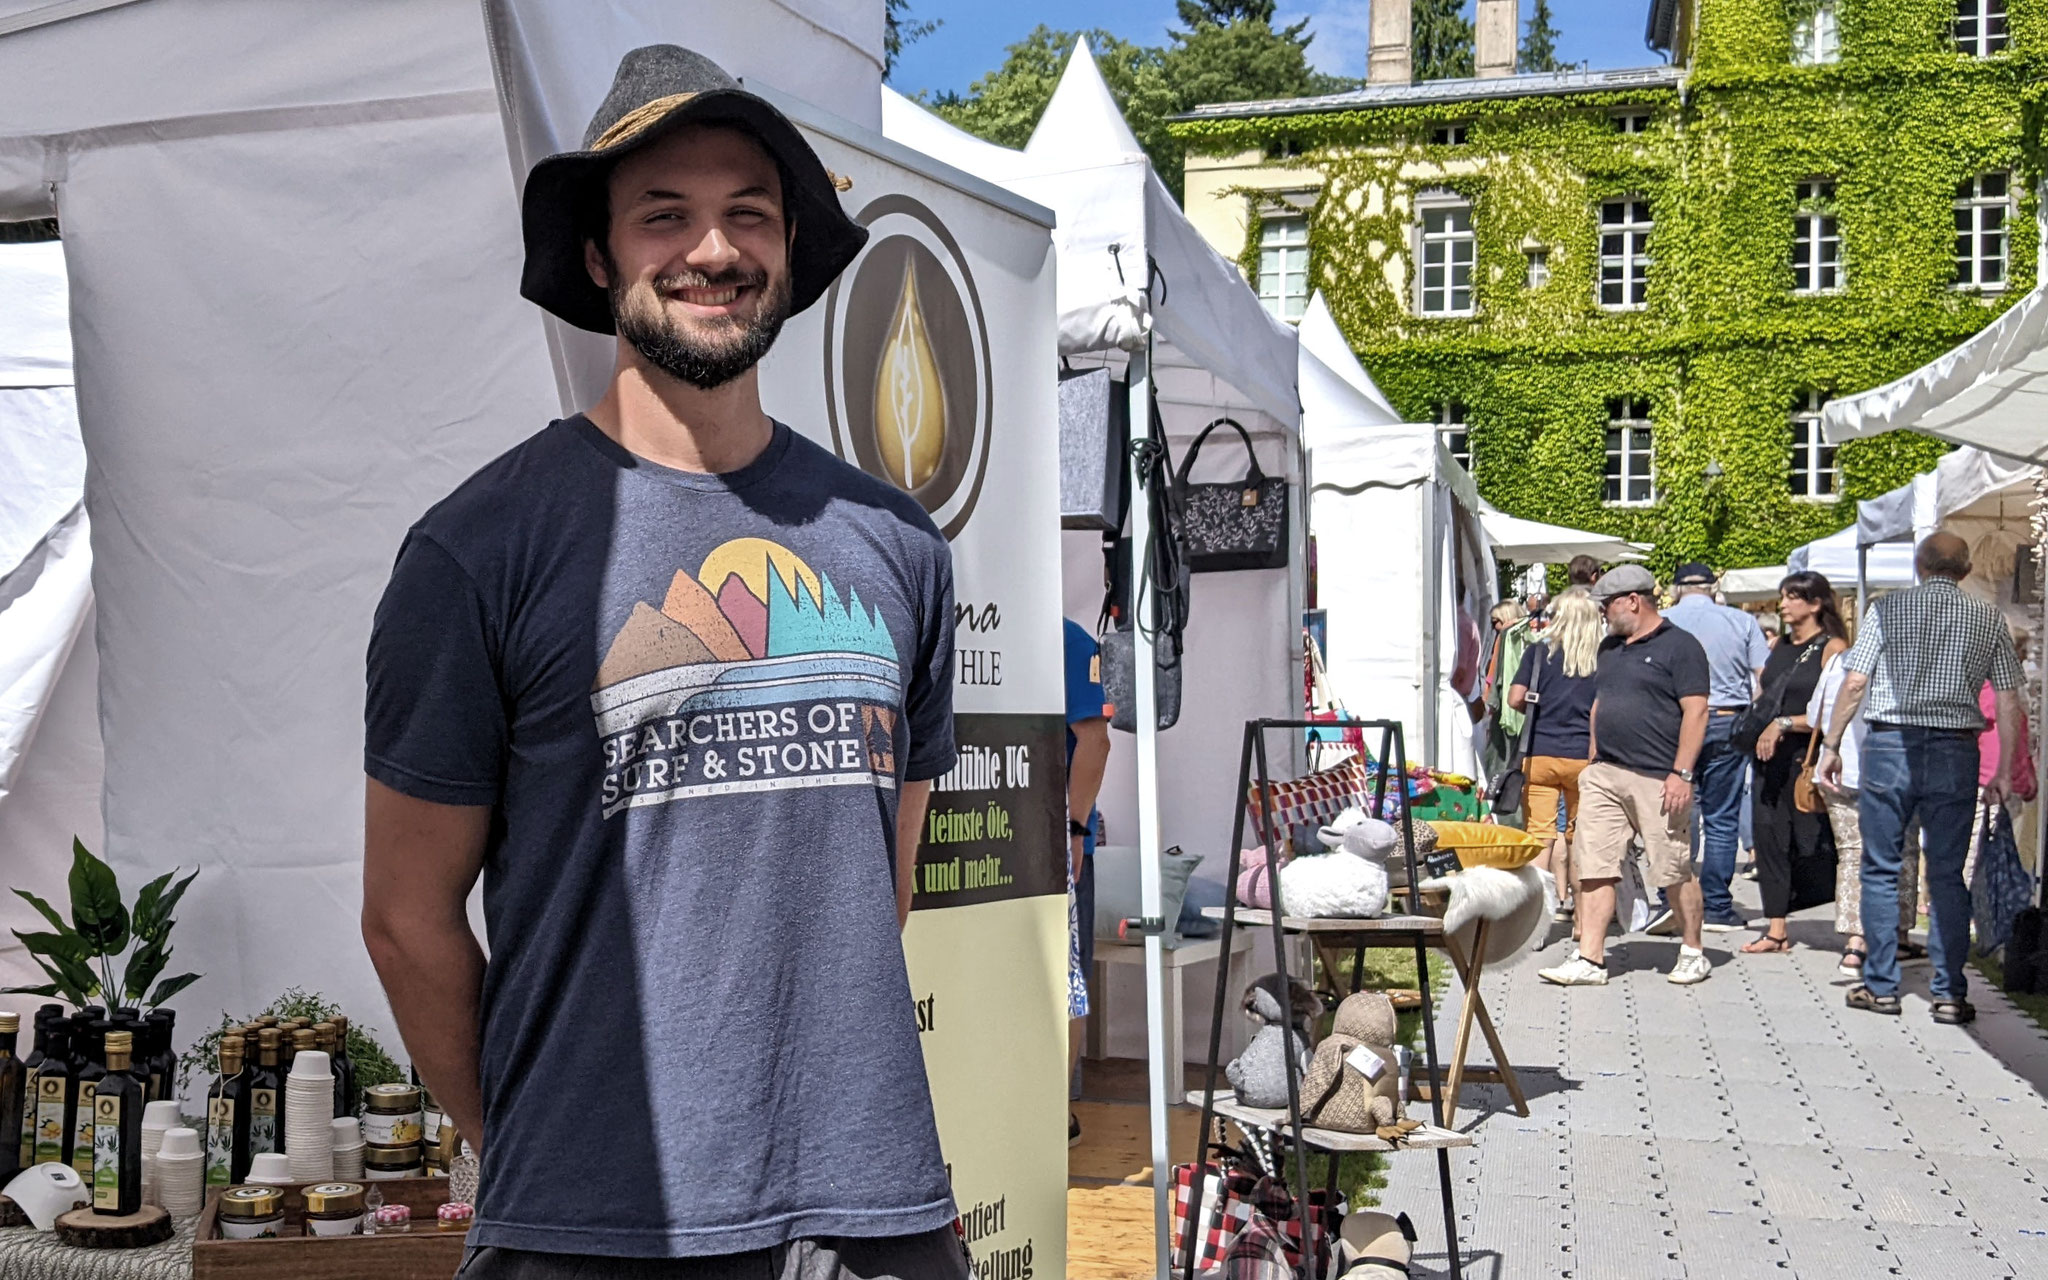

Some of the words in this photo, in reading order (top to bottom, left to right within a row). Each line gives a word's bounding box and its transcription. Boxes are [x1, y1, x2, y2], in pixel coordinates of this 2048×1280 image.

[955, 649, 1002, 686] HLE
[602, 706, 799, 768] SEARCHERS
[808, 703, 856, 734] OF
[601, 754, 688, 804] SURF
[703, 750, 727, 779] &
[737, 739, 861, 776] STONE
[755, 781, 776, 789] IN
[800, 775, 838, 785] THE
[1005, 745, 1030, 788] UG
[929, 807, 983, 844] feinste
[986, 801, 1013, 842] Öle,
[924, 857, 960, 893] und
[965, 854, 1013, 889] mehr...
